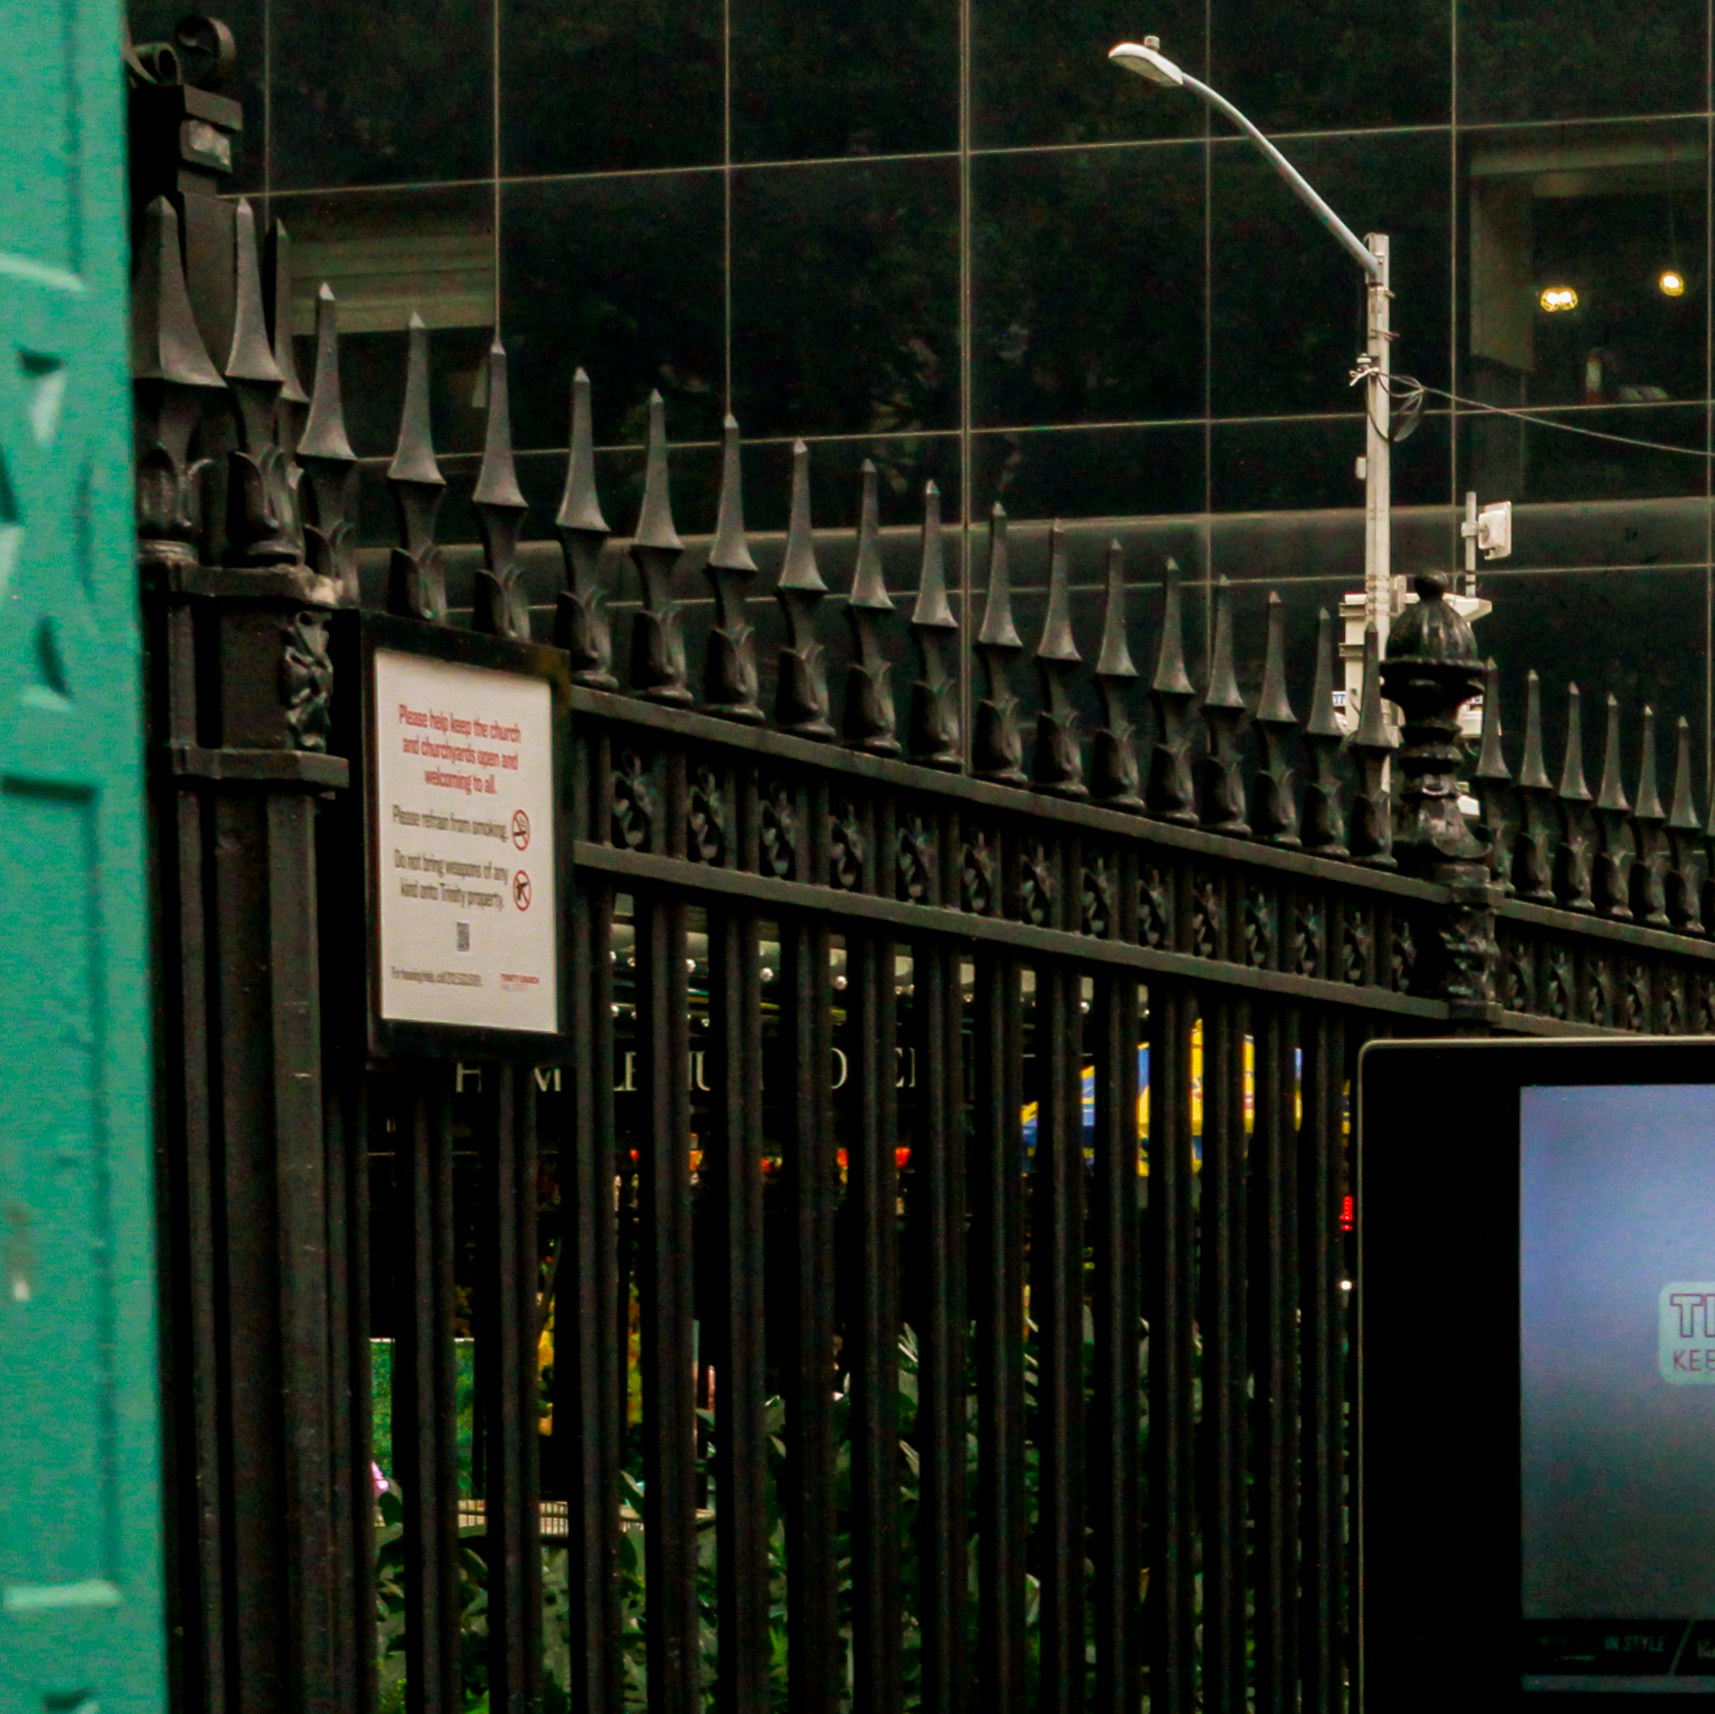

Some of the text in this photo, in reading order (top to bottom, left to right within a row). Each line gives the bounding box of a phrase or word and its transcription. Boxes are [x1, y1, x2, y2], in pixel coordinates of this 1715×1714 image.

[399, 703, 521, 743] Please help keep the church
[403, 736, 419, 754] and
[392, 804, 420, 826] Please
